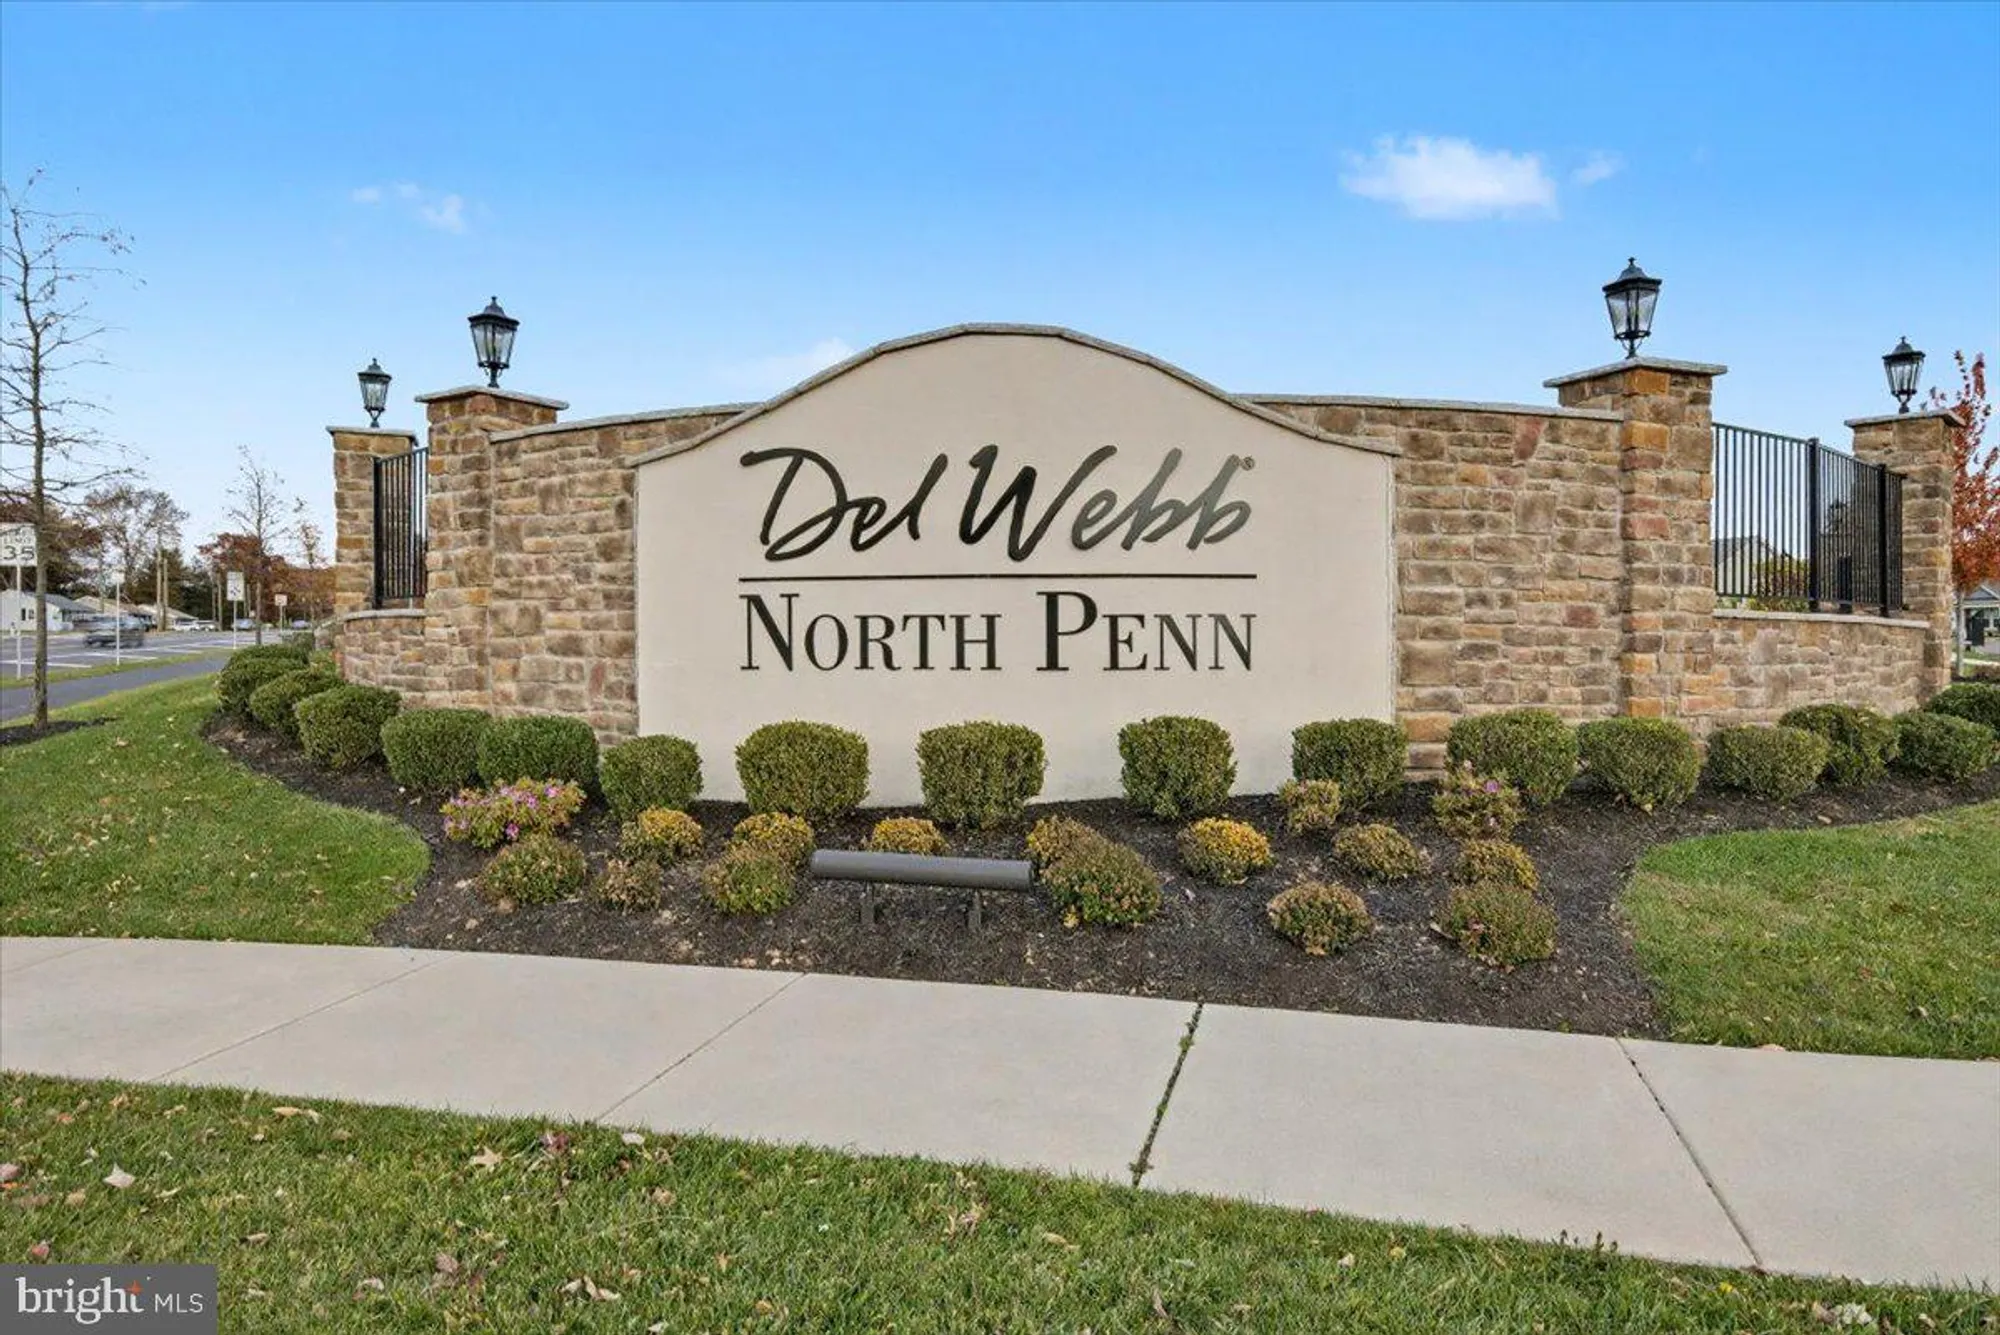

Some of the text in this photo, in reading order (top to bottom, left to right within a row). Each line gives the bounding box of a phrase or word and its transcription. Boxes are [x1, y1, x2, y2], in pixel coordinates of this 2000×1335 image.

[739, 444, 1251, 563] Del Webb
[3, 545, 35, 560] 35
[738, 590, 1258, 672] NORTH PENN
